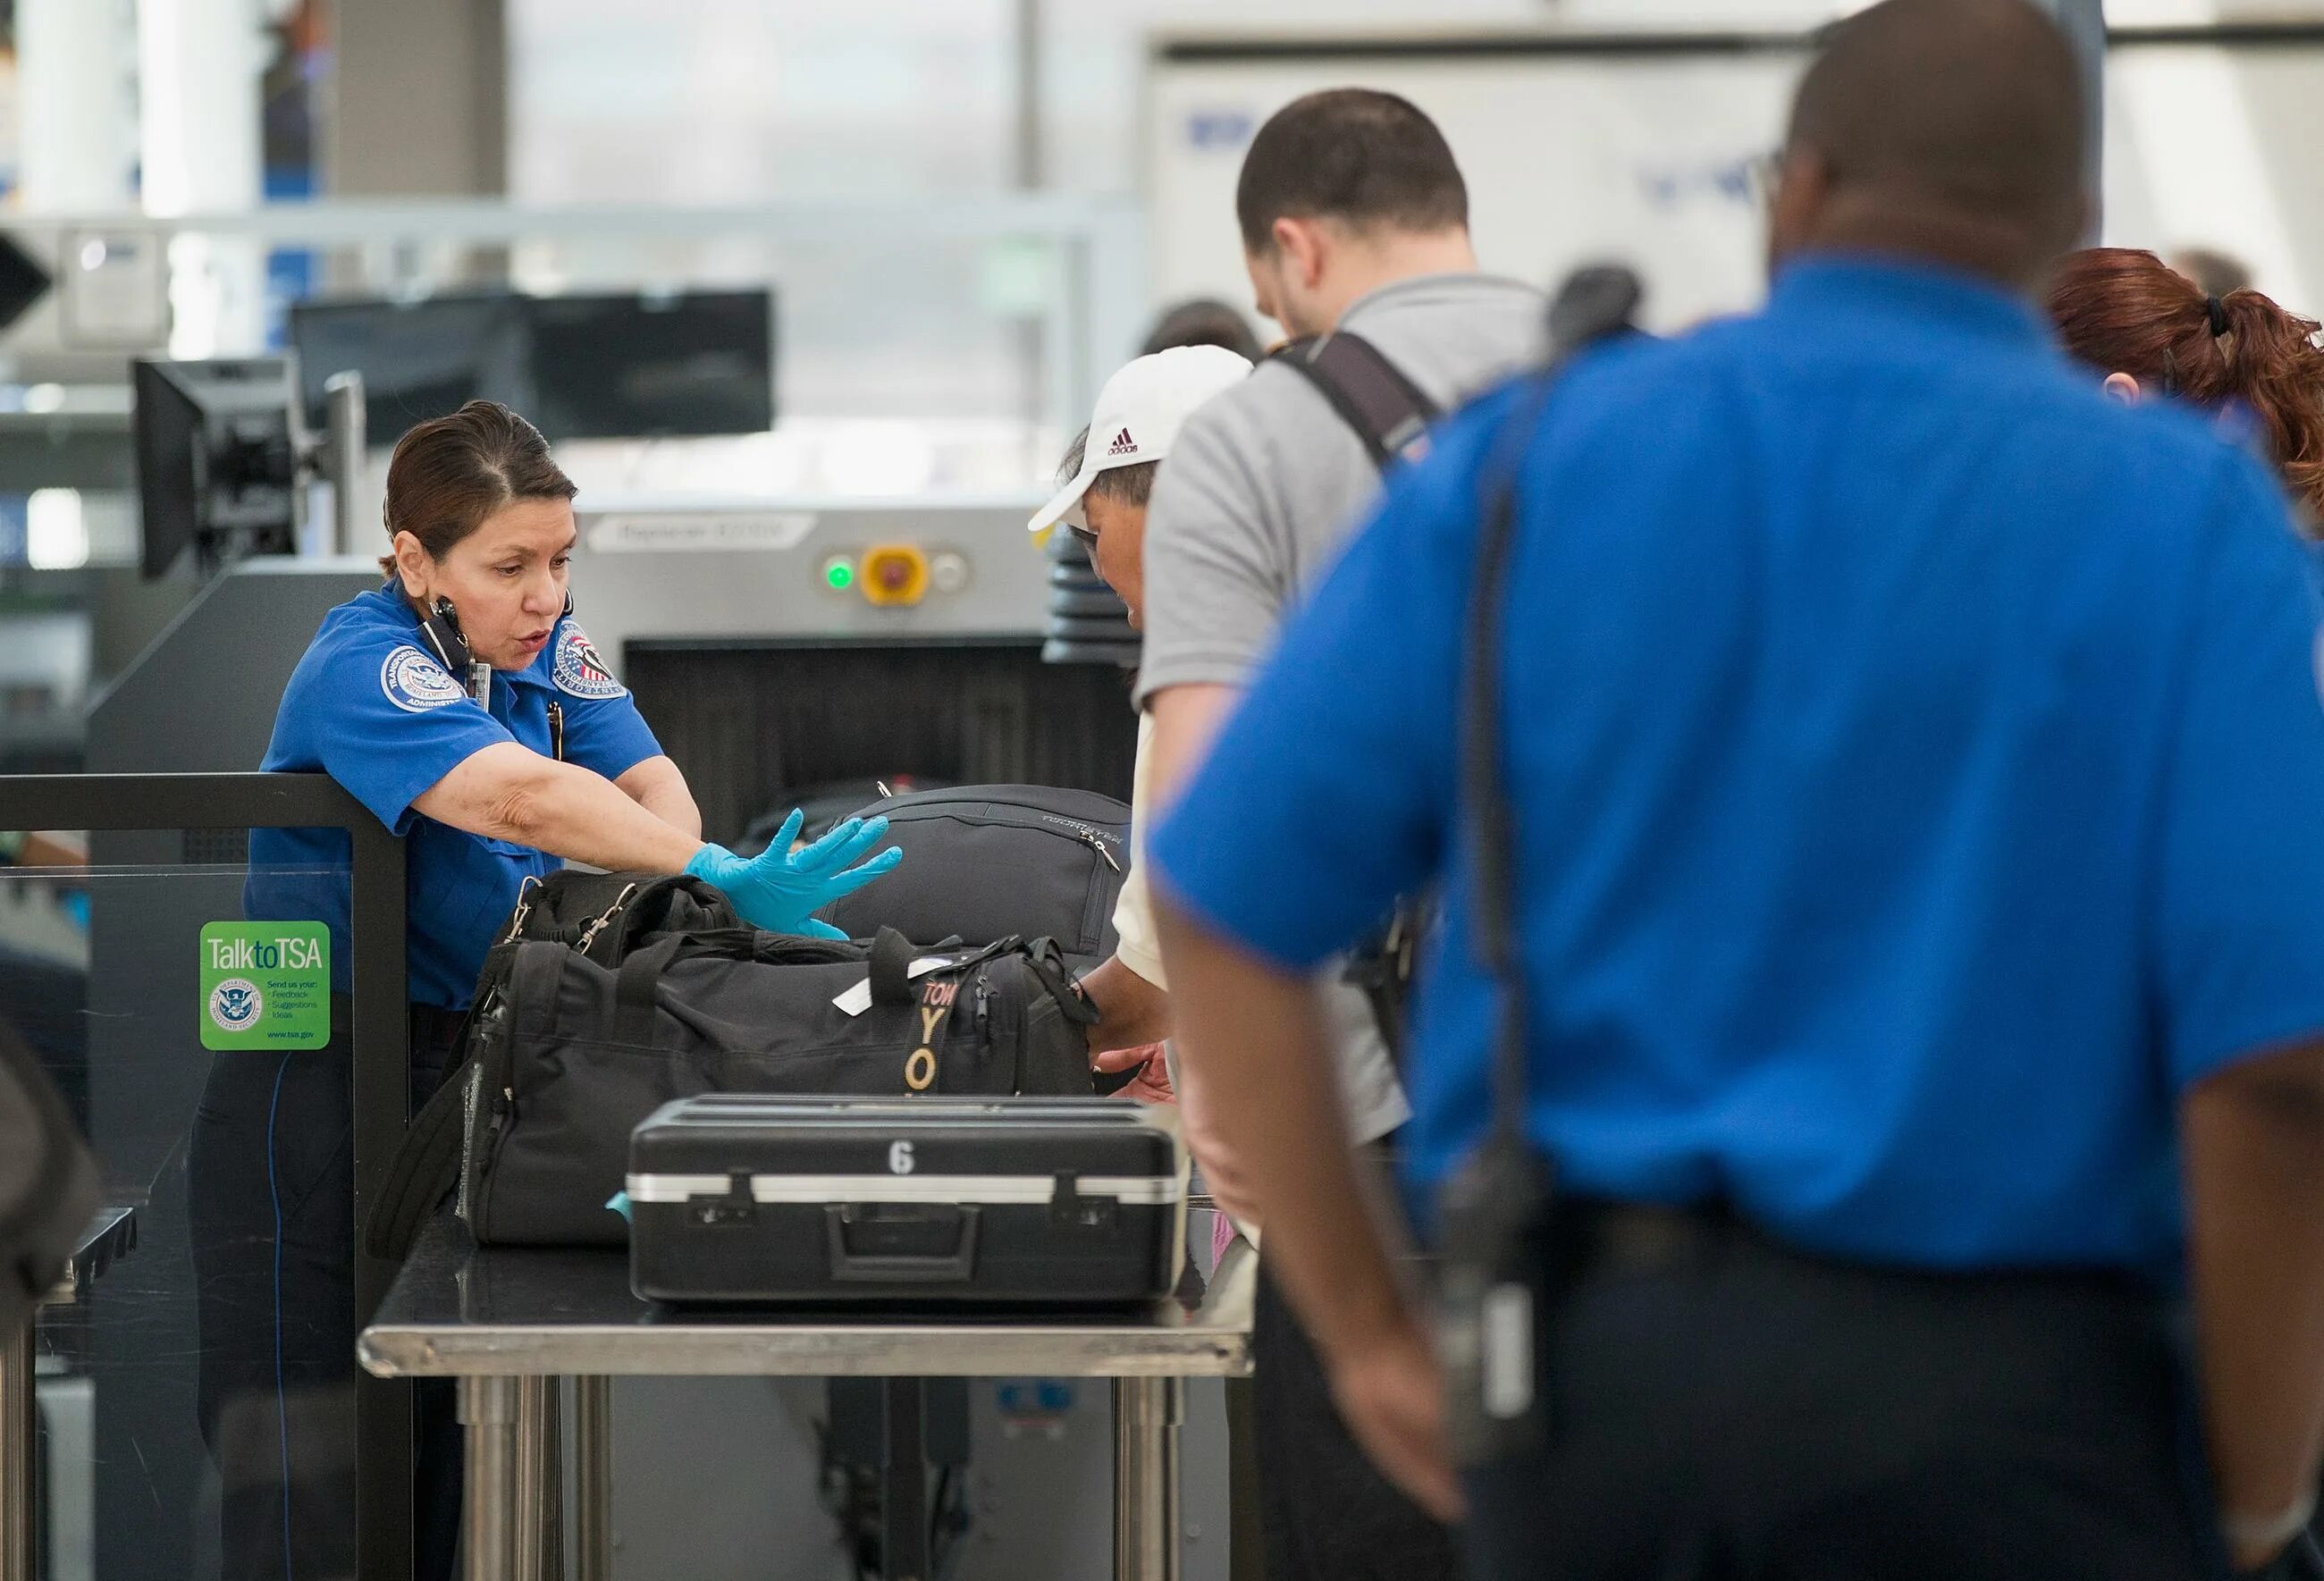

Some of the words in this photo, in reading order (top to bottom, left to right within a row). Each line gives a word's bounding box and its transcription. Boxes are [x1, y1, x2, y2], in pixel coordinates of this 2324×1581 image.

[1108, 444, 1138, 456] adidas
[552, 668, 614, 694] INTEGRITY
[267, 980, 287, 988] Send
[272, 1002, 317, 1010] Suggestions
[272, 1011, 293, 1019] Ideas
[888, 1139, 915, 1174] 6
